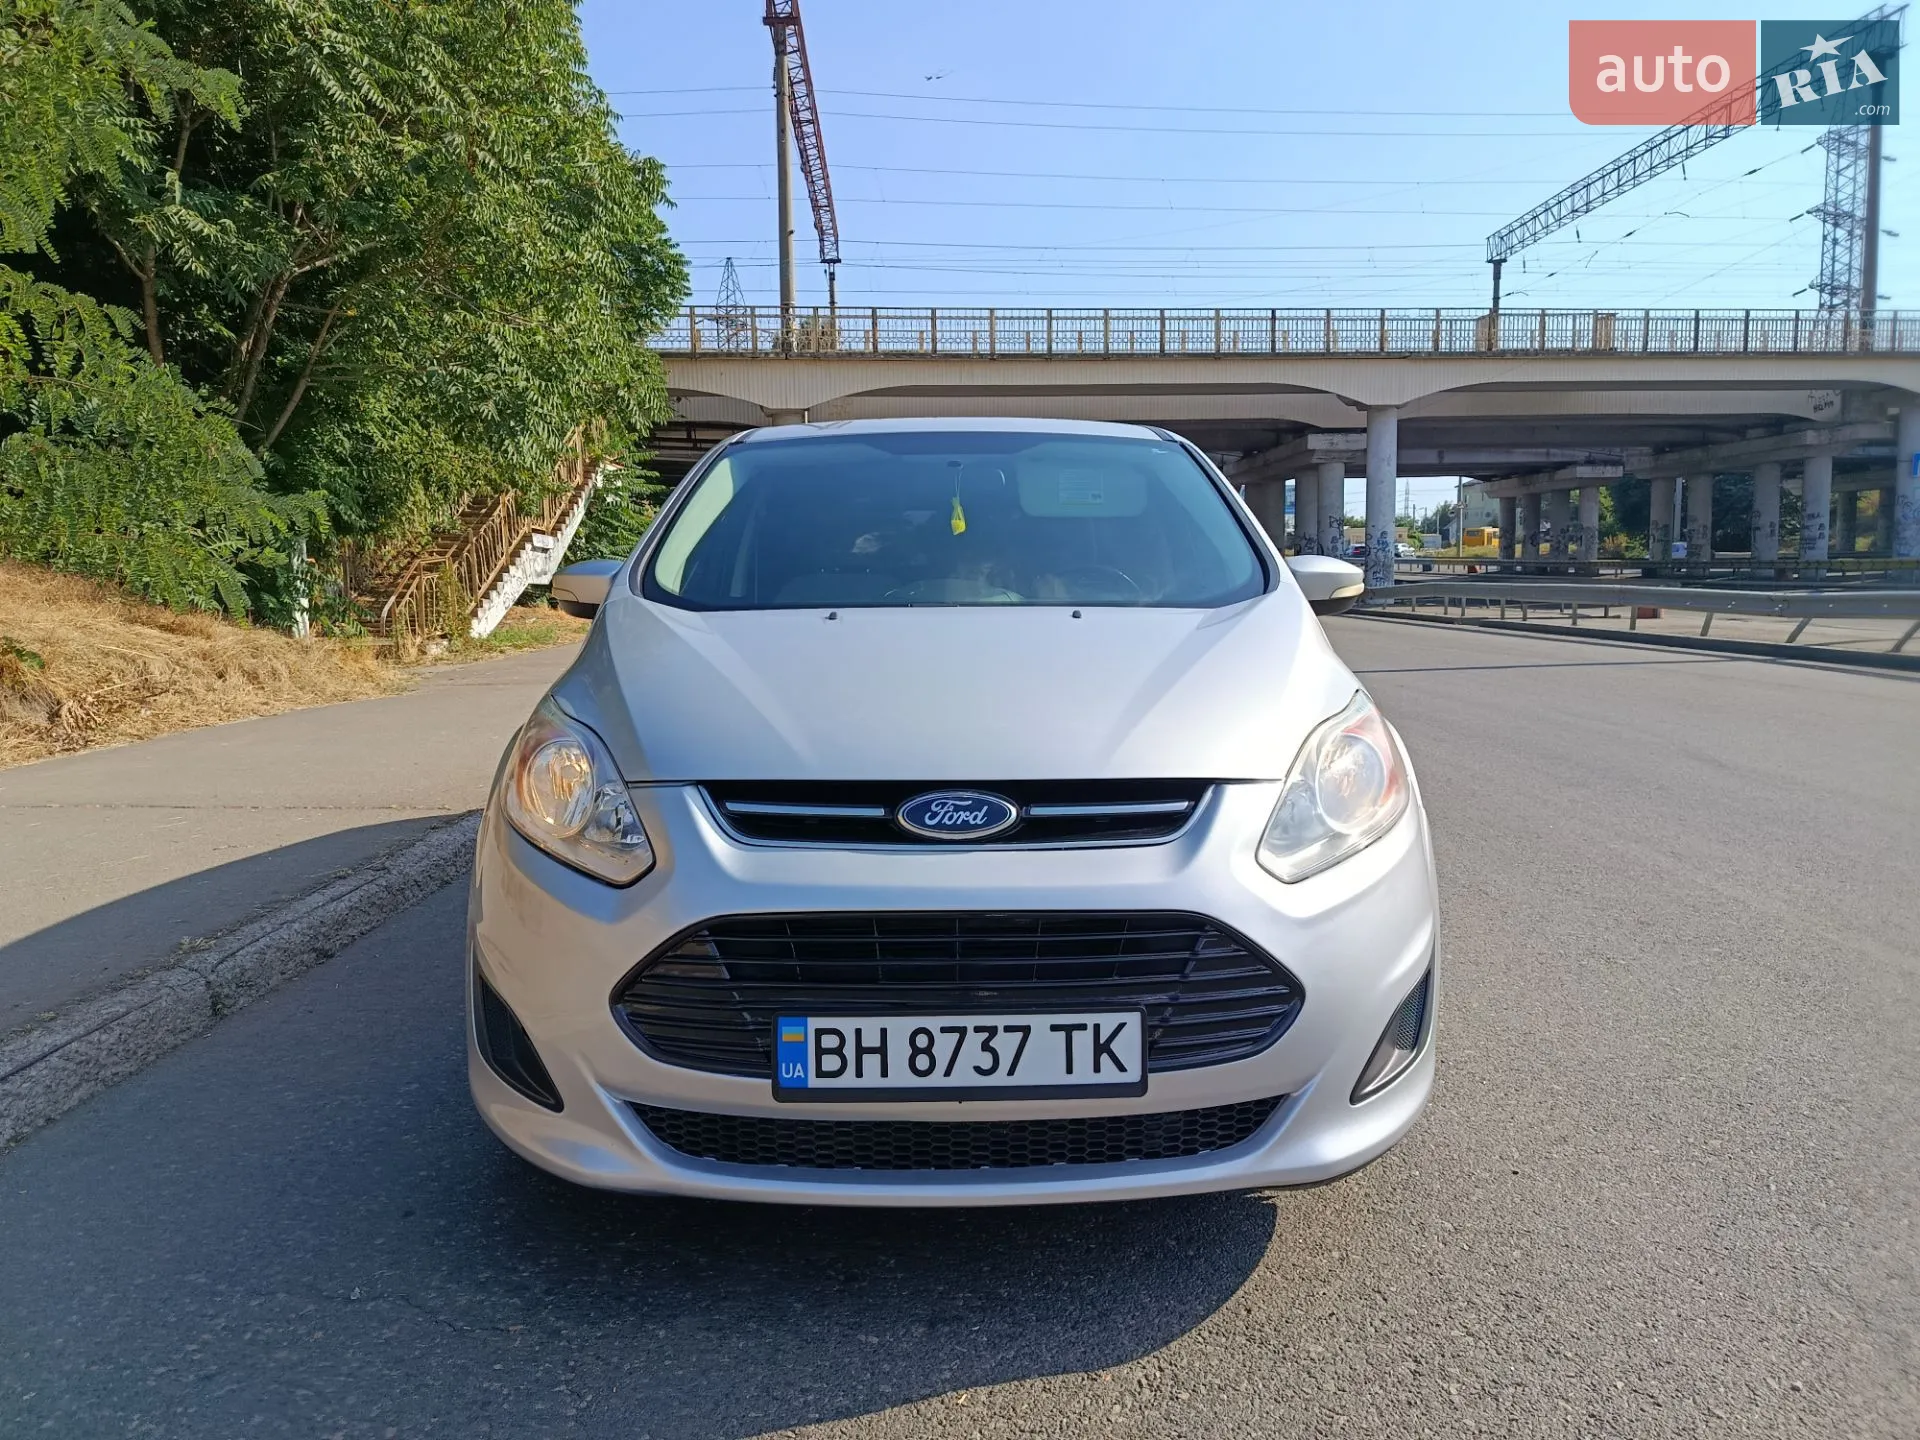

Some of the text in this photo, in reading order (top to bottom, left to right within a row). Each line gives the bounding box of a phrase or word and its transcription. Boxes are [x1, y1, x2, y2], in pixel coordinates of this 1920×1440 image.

[924, 799, 989, 825] Ford
[814, 1022, 1128, 1079] BH 8737 TK
[782, 1063, 805, 1079] UA
